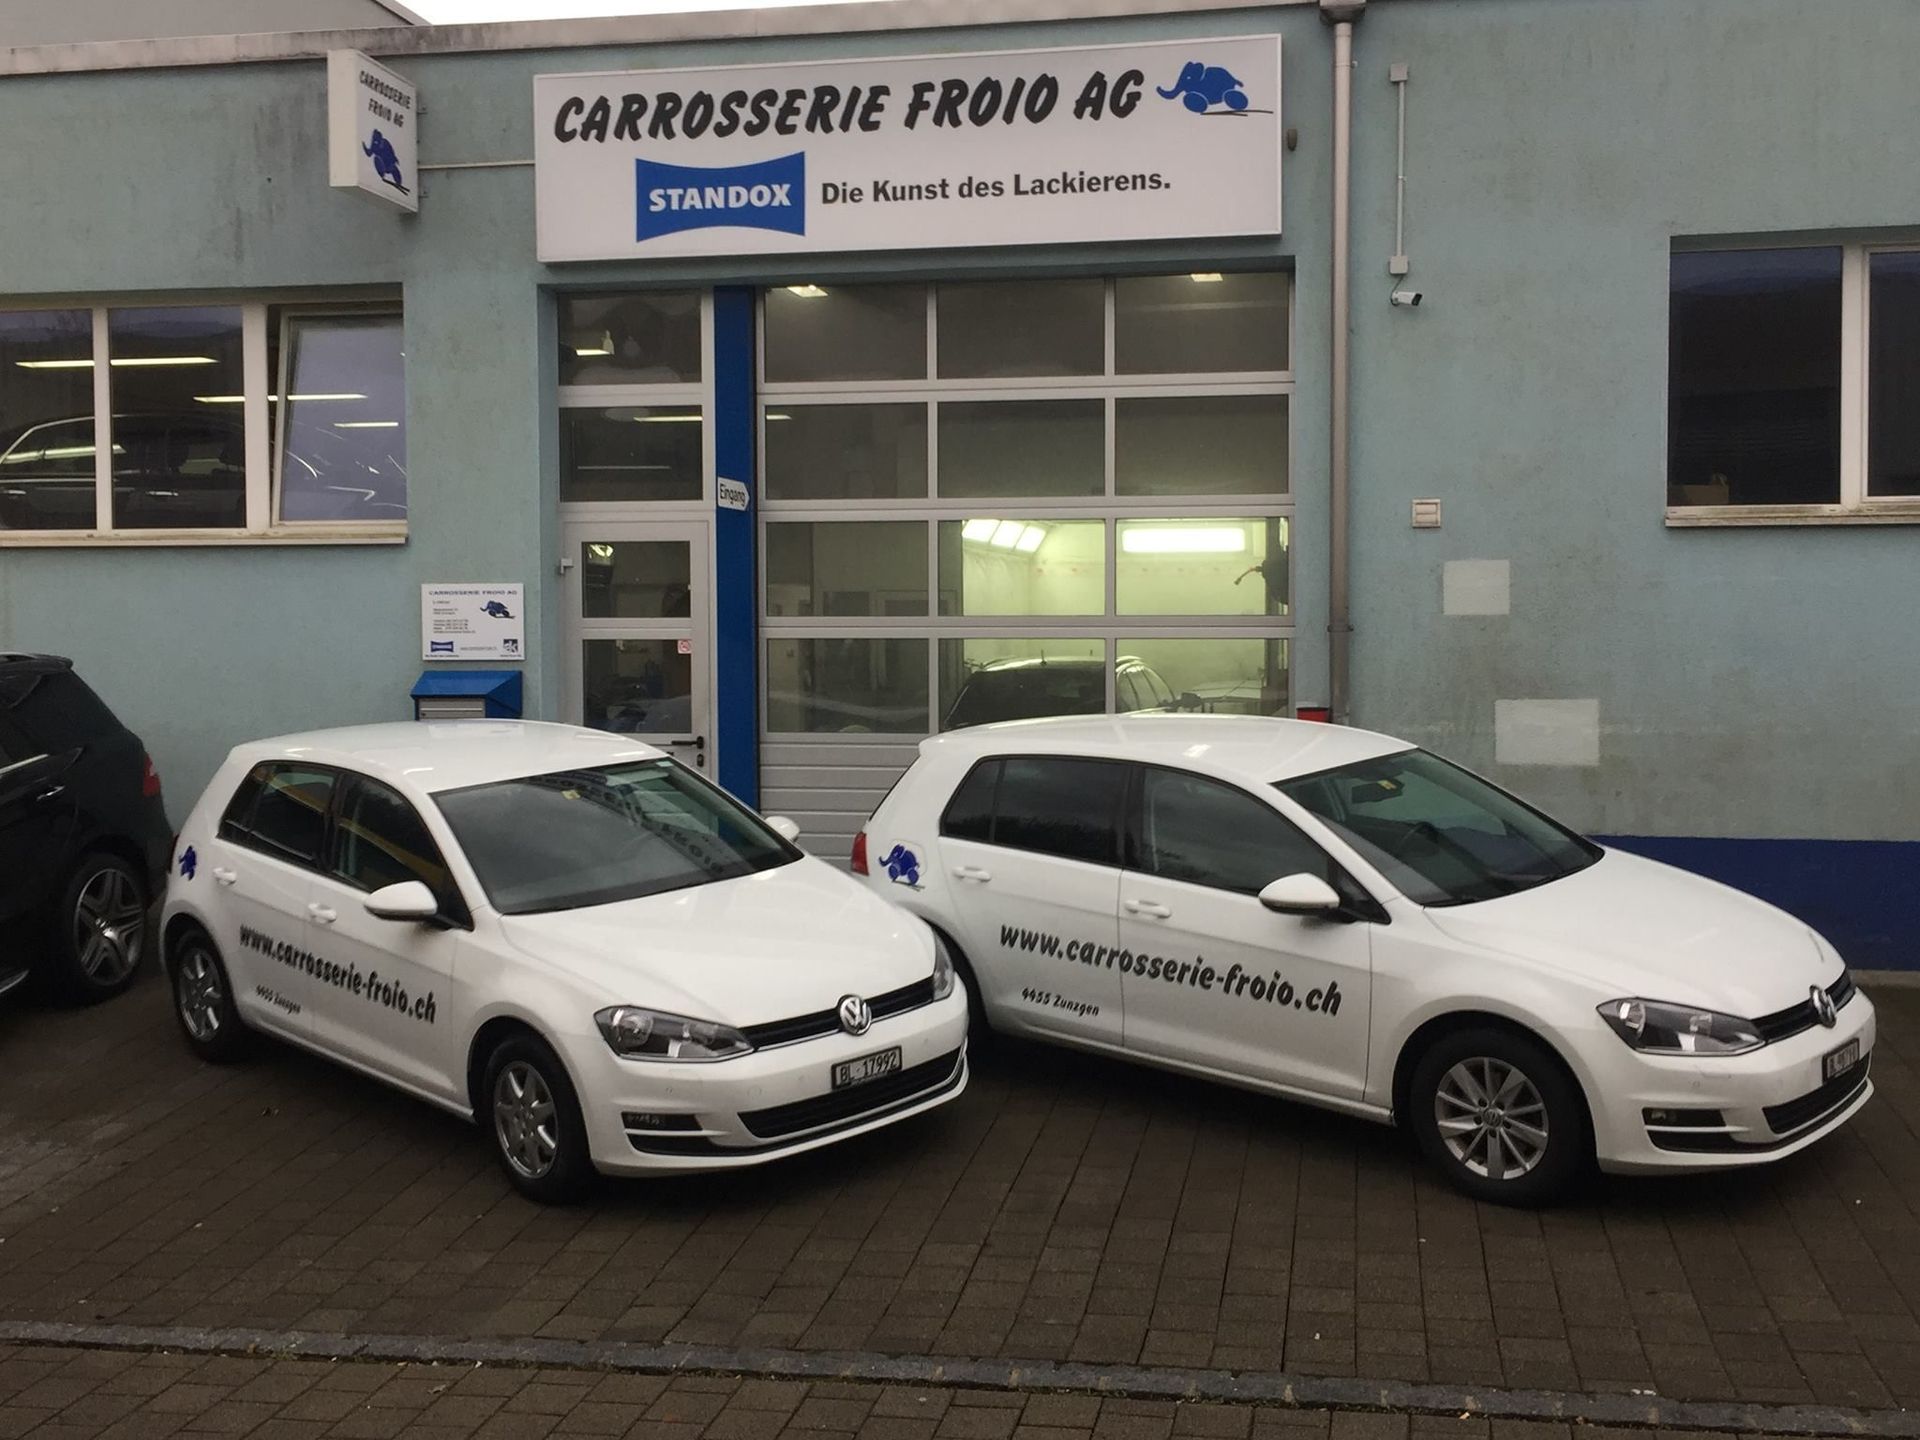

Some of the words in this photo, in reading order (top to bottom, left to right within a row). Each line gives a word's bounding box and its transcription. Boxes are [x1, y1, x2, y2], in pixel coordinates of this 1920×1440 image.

[359, 70, 411, 109] CARROSSERIE
[555, 85, 890, 143] CARROSSERIE
[905, 74, 1058, 130] FROIO
[1074, 70, 1144, 120] AG
[368, 98, 392, 121] FROIO
[393, 112, 404, 127] AG
[649, 184, 792, 212] STANDOX
[823, 182, 864, 205] Die
[873, 178, 950, 203] Kunst
[958, 175, 1005, 199] des
[1014, 170, 1171, 197] Lackierens.
[239, 924, 436, 1025] www.carrosserie-froio.ch
[1000, 923, 1343, 1017] www.carrosserie-froio.ch
[1021, 987, 1052, 1005] 4455
[1053, 994, 1100, 1017] Zunzgen
